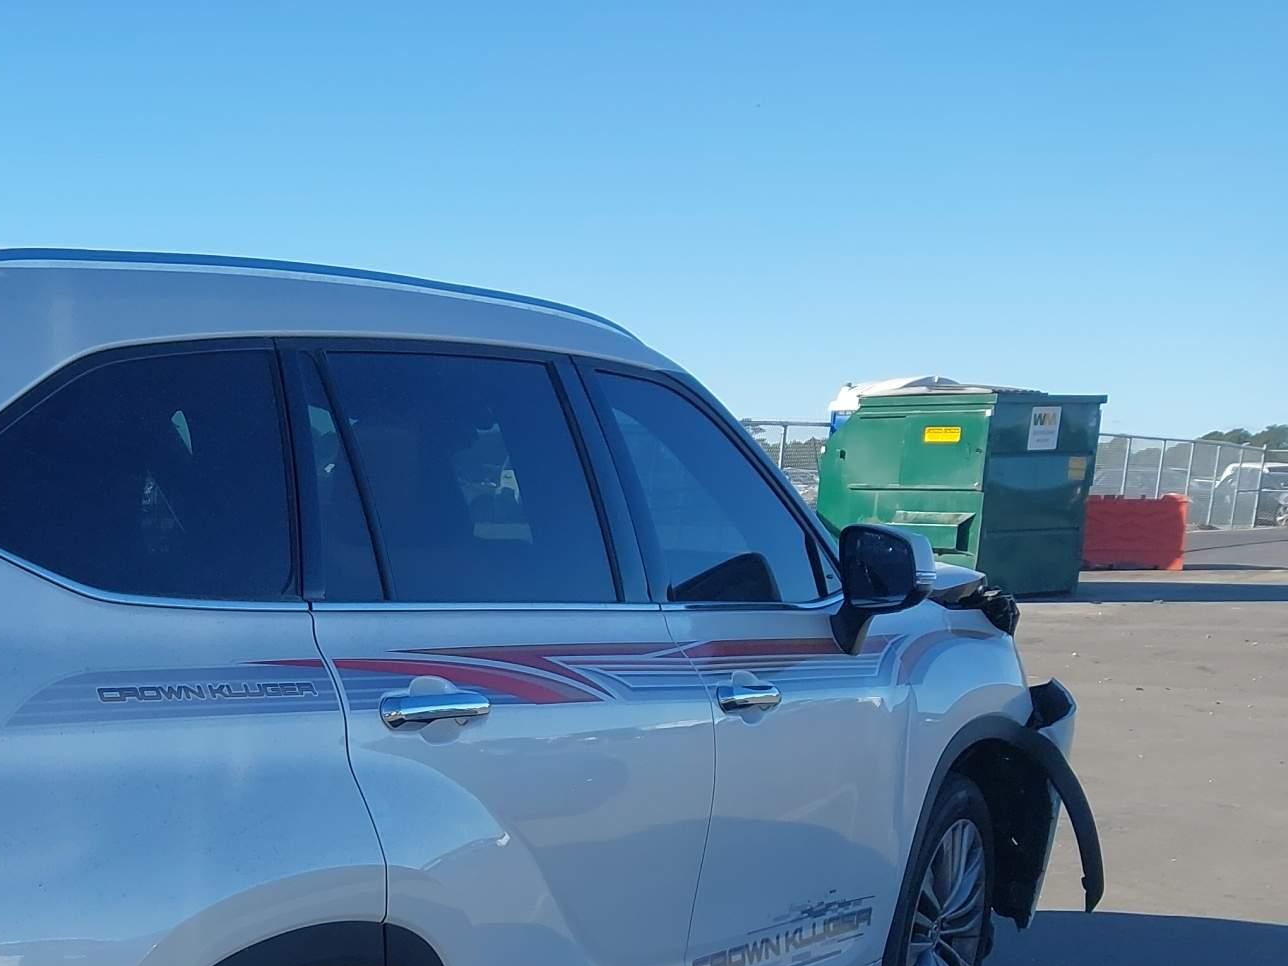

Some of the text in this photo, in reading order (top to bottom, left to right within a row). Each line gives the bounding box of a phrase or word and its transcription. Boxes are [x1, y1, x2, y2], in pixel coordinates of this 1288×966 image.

[1033, 412, 1057, 427] WM
[96, 682, 318, 703] CROWN KLUGER
[785, 906, 873, 953] KLUGER
